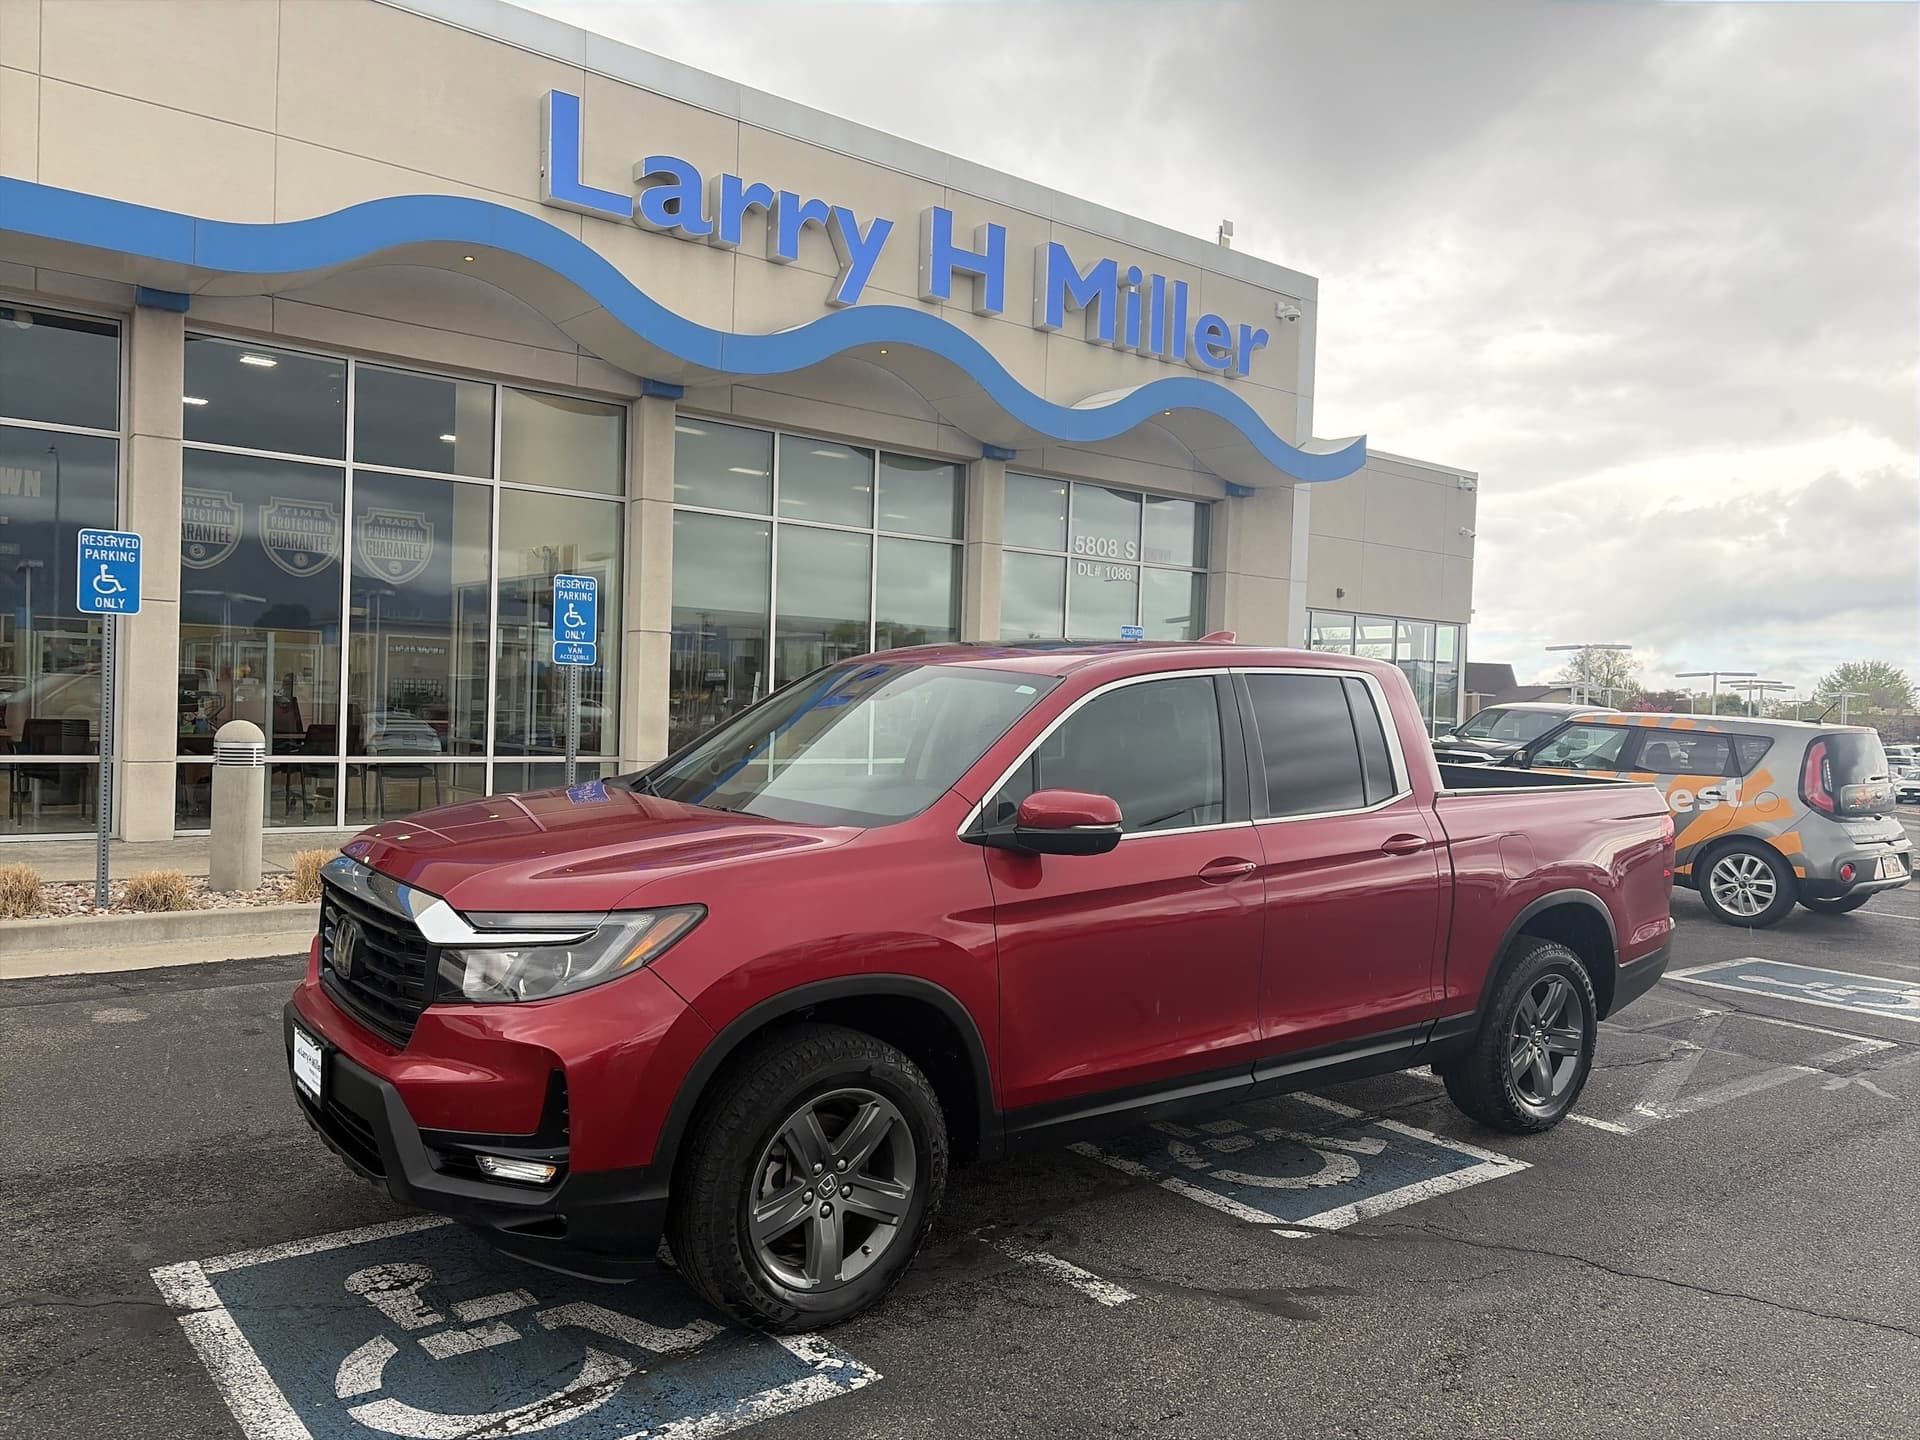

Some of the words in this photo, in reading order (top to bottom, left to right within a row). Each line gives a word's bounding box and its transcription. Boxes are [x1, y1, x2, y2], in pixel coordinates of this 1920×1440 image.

[540, 89, 894, 307] Larry
[918, 206, 1006, 317] H
[1033, 241, 1269, 377] Miller
[184, 496, 223, 508] RICE
[182, 507, 231, 523] TECTION
[280, 507, 322, 518] TIME
[271, 515, 332, 534] PROTECTION
[376, 517, 416, 528] TRADE
[182, 523, 232, 543] RANTEE
[368, 526, 424, 542] PROTECTION
[81, 534, 140, 549] RESERVED
[269, 531, 334, 553] GUARANTEE
[1074, 535, 1118, 557] 5808
[1125, 540, 1136, 559] S
[85, 548, 136, 563] PARKING
[366, 540, 425, 560] GUARANTEE
[1077, 562, 1101, 577] DL#
[1105, 566, 1132, 580] 1086
[556, 579, 595, 591] RESERVED
[95, 597, 125, 609] ONLY
[558, 591, 593, 602] PARKING
[565, 630, 586, 640] ONLY
[567, 646, 583, 655] VAN
[1669, 778, 1744, 813] est
